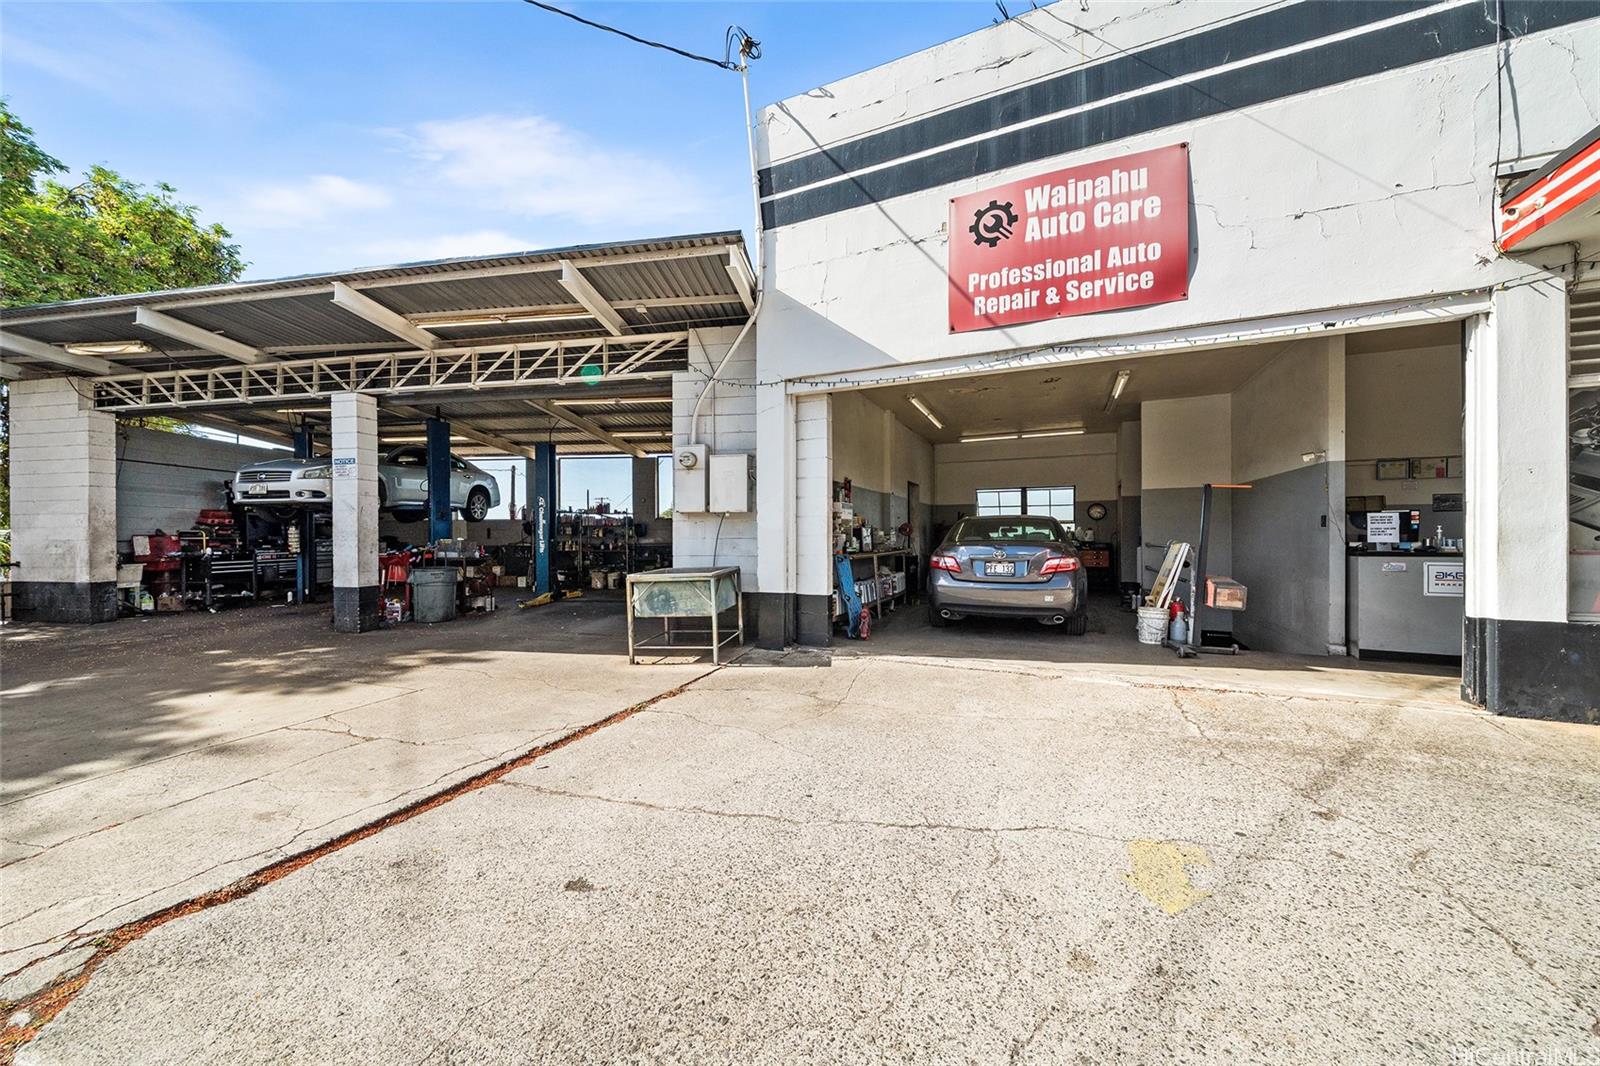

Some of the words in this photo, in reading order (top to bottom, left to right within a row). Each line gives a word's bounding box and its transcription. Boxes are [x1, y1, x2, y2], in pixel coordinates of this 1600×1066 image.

[1024, 167, 1148, 212] Waipahu
[1024, 211, 1085, 242] Auto
[1093, 196, 1162, 228] Care
[968, 249, 1101, 292] Professional
[1107, 242, 1162, 266] Auto
[974, 290, 1040, 315] Repair
[1045, 286, 1061, 305] &
[1065, 271, 1154, 301] Service
